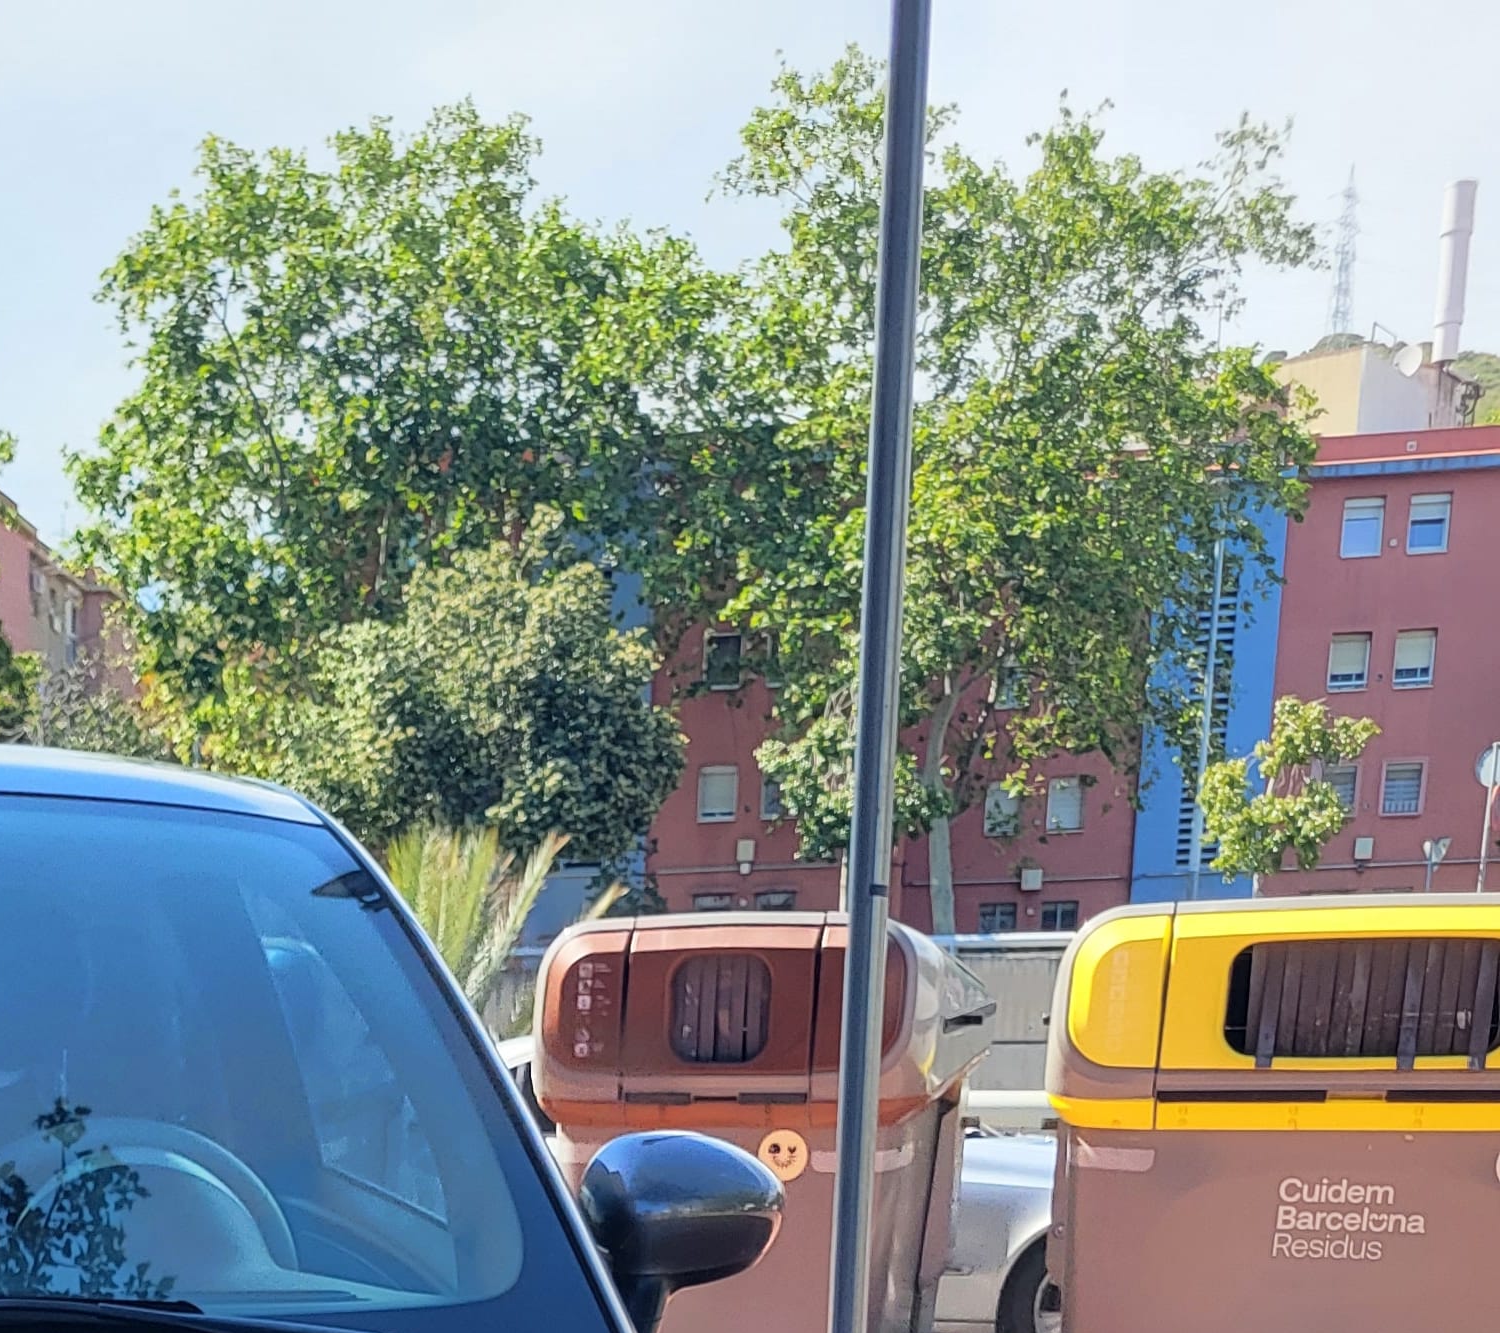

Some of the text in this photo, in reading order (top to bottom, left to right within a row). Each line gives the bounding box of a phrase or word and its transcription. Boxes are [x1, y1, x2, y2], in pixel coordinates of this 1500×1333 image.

[1279, 1177, 1395, 1204] Cuidem
[1276, 1205, 1426, 1234] Barcelona
[1272, 1232, 1383, 1260] Residus
